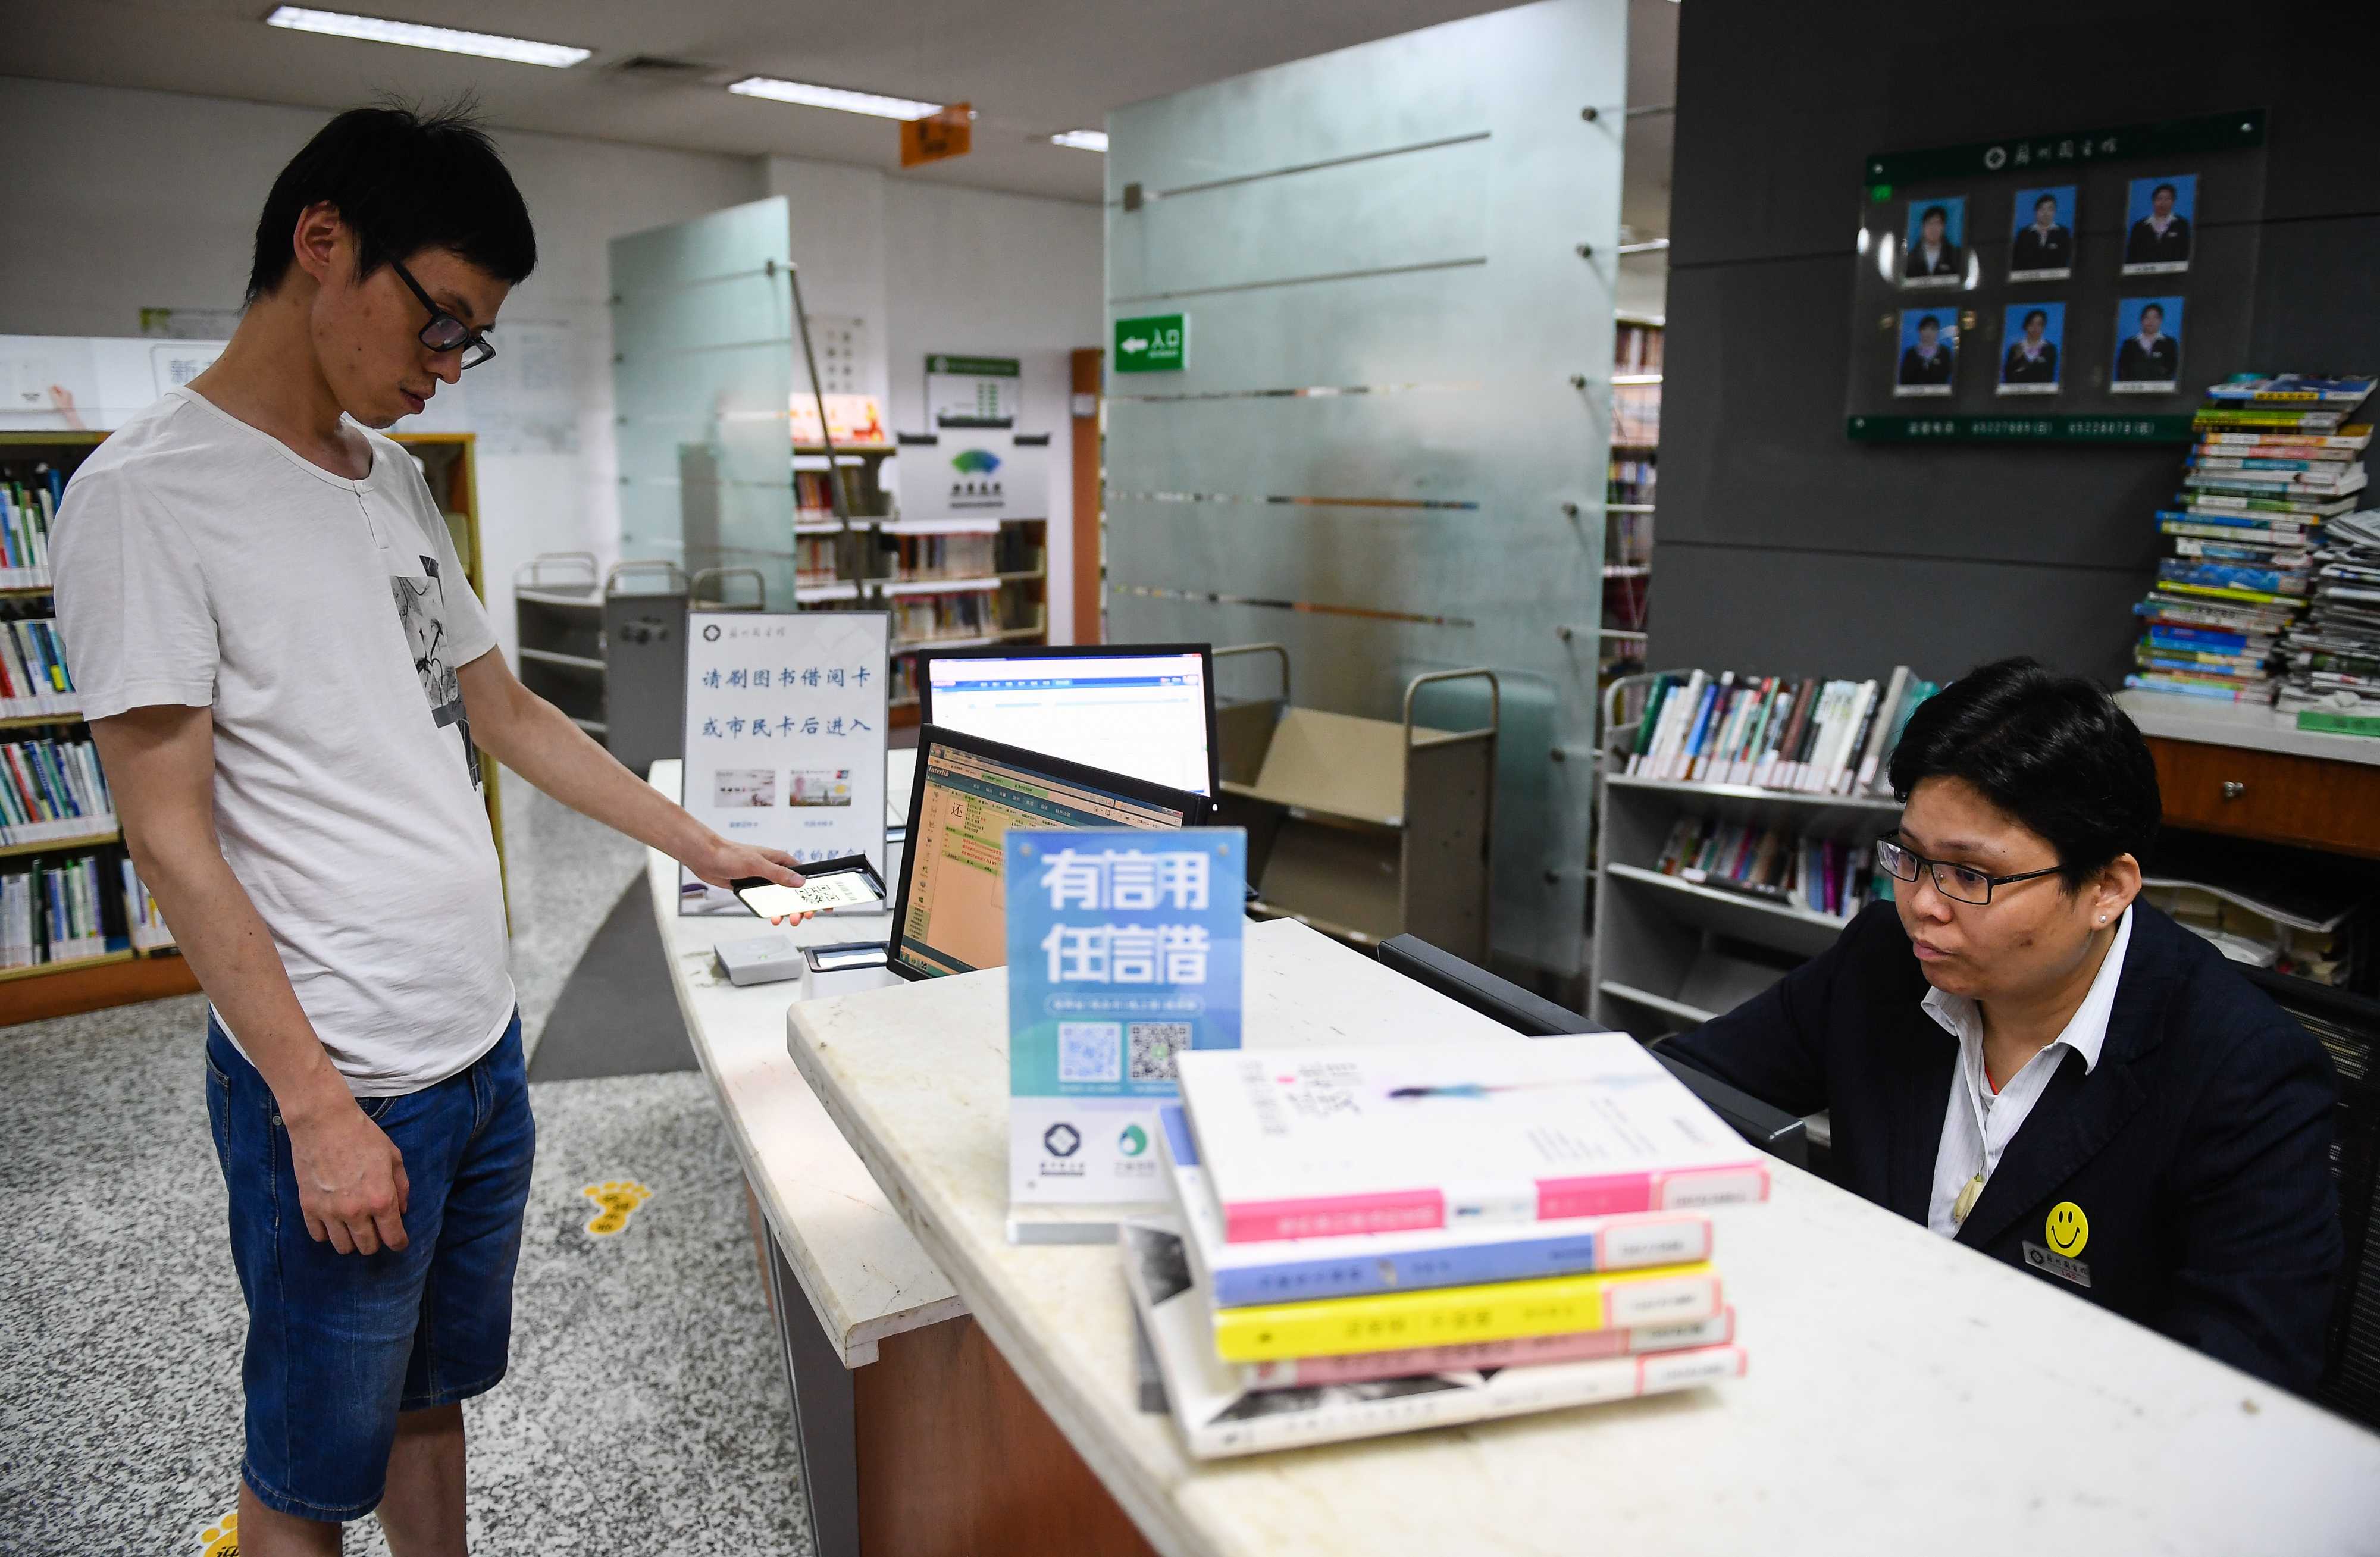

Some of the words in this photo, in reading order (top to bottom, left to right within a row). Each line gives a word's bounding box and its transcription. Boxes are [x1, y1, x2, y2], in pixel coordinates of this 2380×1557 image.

[1150, 328, 1180, 351] 入口
[703, 666, 871, 688] 请刷图书借阅卡
[702, 716, 871, 739] 或市民卡后进入
[928, 765, 950, 778] Interlib
[951, 802, 963, 817] 还
[1040, 848, 1210, 910] 有信用
[1040, 923, 1211, 985] 任信借
